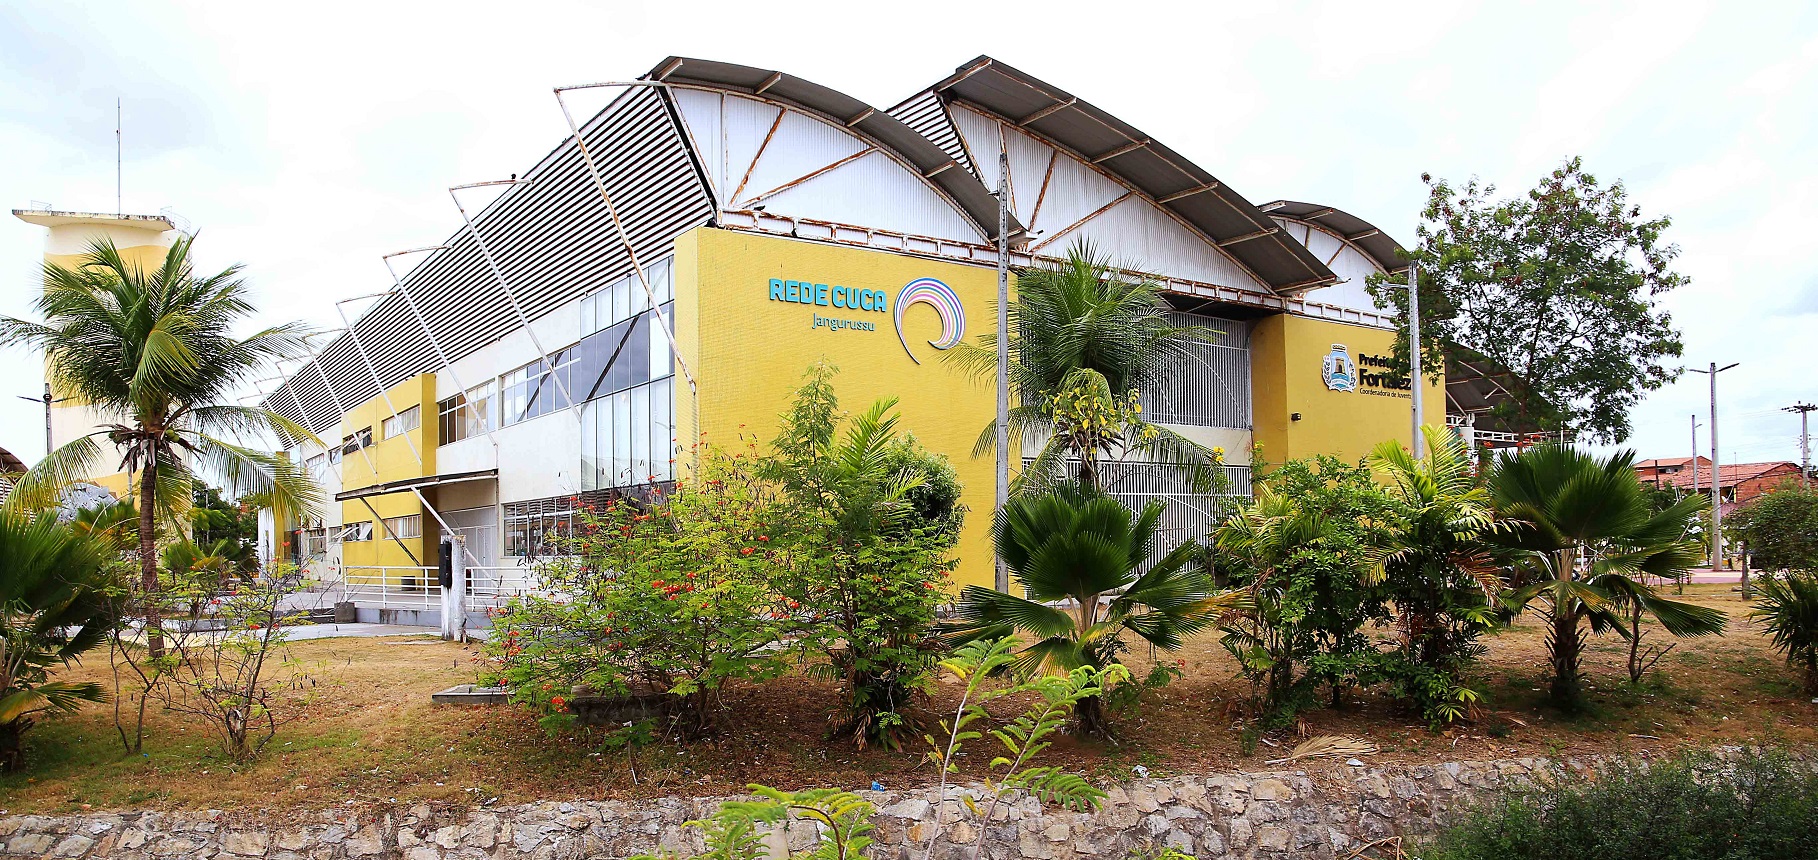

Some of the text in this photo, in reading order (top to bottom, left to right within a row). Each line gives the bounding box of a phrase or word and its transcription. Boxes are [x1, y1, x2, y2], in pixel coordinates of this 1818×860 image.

[769, 278, 887, 313] REDE CUCA
[1360, 388, 1390, 397] Coordenadoria
